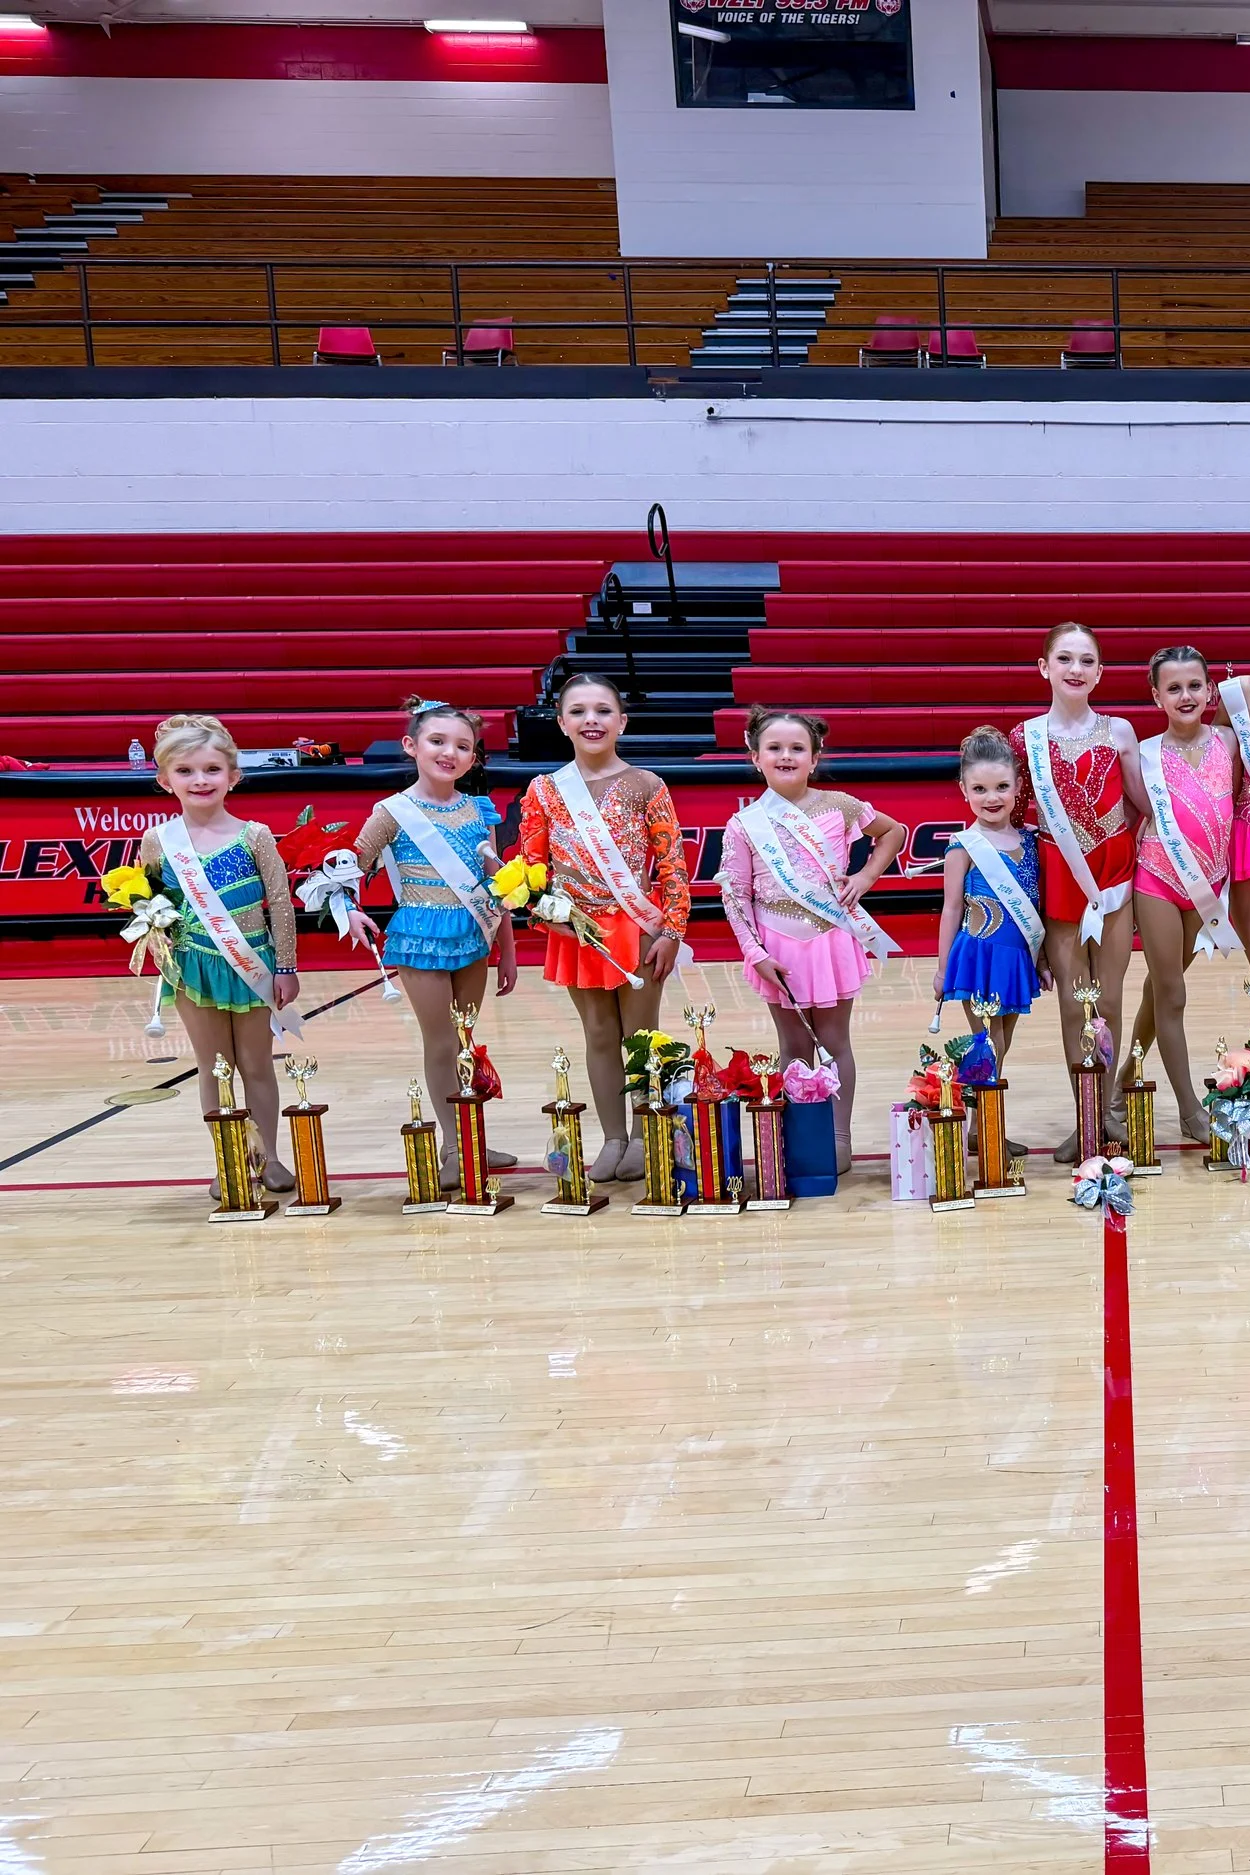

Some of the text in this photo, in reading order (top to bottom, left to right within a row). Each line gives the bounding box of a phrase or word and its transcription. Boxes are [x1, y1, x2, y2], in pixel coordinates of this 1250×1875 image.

[717, 12, 860, 25] VOICE OF THE TIGERS!
[1030, 743, 1045, 782] Rainbow
[1036, 784, 1056, 819] Princess
[1151, 783, 1163, 796] 2026
[782, 812, 799, 820] 2026
[794, 822, 825, 858] Rainbow
[1156, 798, 1171, 837] Rainbow
[585, 825, 610, 864] Rainbow
[607, 867, 629, 889] Most
[621, 891, 657, 923] Beautiful
[1167, 838, 1188, 871] Princess
[762, 843, 844, 919] 2026 Rainbow Sweetheart
[174, 851, 190, 865] 2026
[182, 867, 209, 909] Rainbow
[205, 912, 229, 934] Most
[221, 935, 260, 973] Beautiful
[470, 896, 494, 929] Rainbow
[997, 883, 1032, 932] 2026 Rainbow
[727, 1176, 743, 1191] 2026
